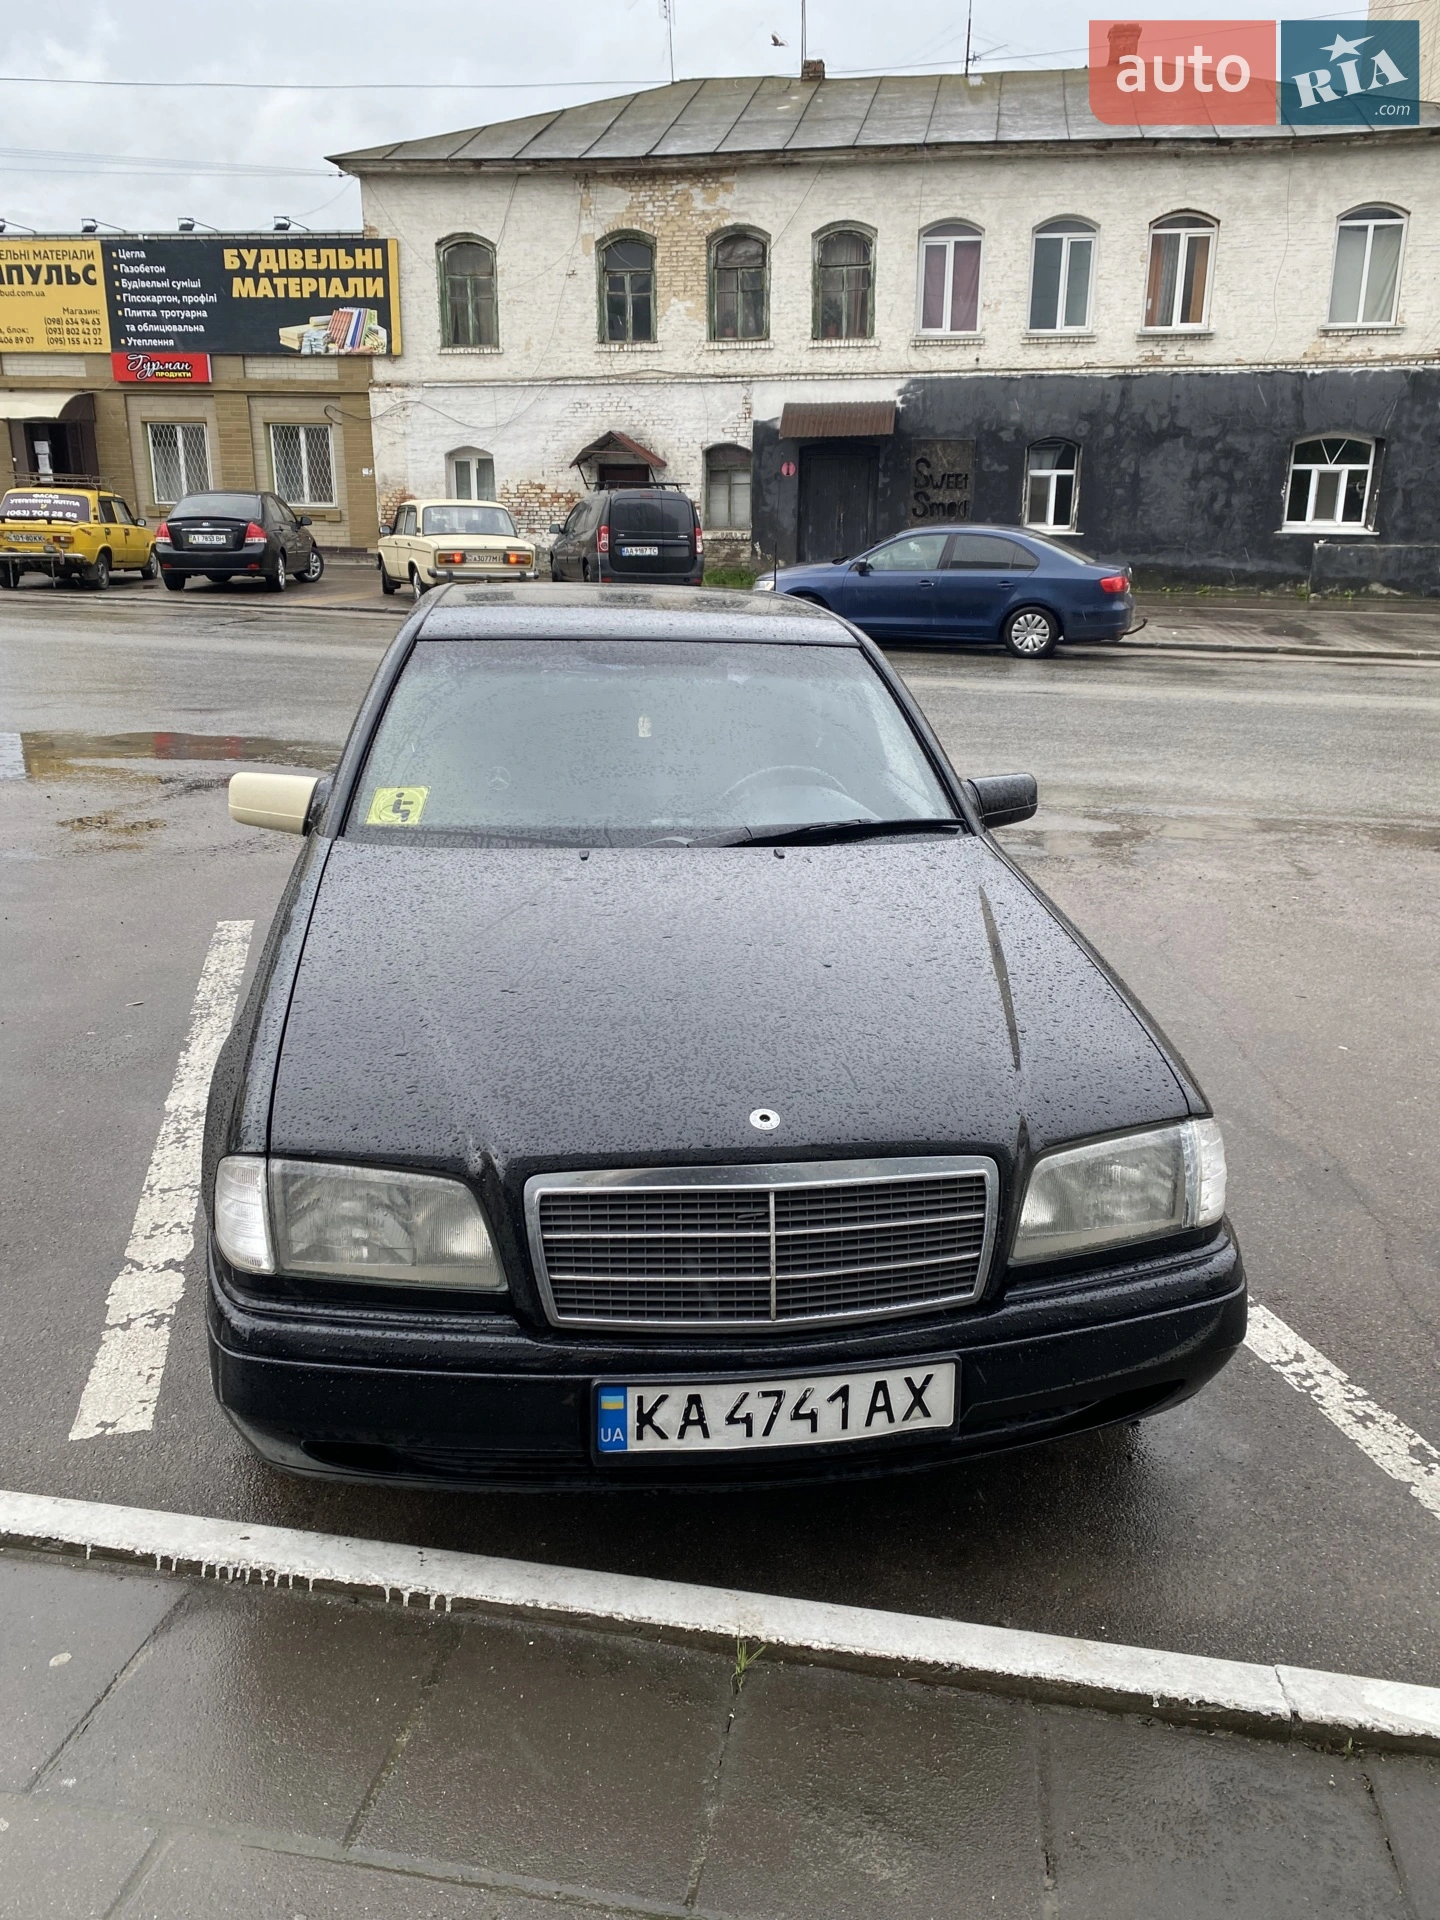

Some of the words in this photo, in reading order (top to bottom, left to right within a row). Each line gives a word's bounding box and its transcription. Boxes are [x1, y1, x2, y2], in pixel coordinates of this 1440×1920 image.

[33, 249, 95, 260] МАТЕРІАЛИ
[118, 249, 146, 260] Цегла
[223, 248, 383, 274] БУДІВЕЛЬНІ
[119, 263, 166, 274] Газобетон
[121, 278, 170, 289] Будівельні
[171, 278, 201, 290] суміші
[232, 277, 384, 298] МАТЕРІАЛИ
[122, 292, 181, 304] Гіпсокартон,
[182, 293, 218, 305] профілі
[62, 307, 101, 315] Магазин:
[124, 307, 157, 317] Плитка
[160, 309, 208, 319] тротуарна
[44, 317, 63, 326] (098)
[65, 317, 79, 326] 634
[125, 323, 136, 332] та
[137, 322, 205, 332] облицювальна
[45, 327, 65, 337] (093)
[66, 327, 80, 336] 802
[127, 337, 175, 347] Утеплення
[127, 354, 192, 380] Гурман
[635, 1393, 711, 1441] KA
[724, 1383, 850, 1438] 4741
[864, 1373, 934, 1427] AX
[601, 1427, 624, 1442] UA
